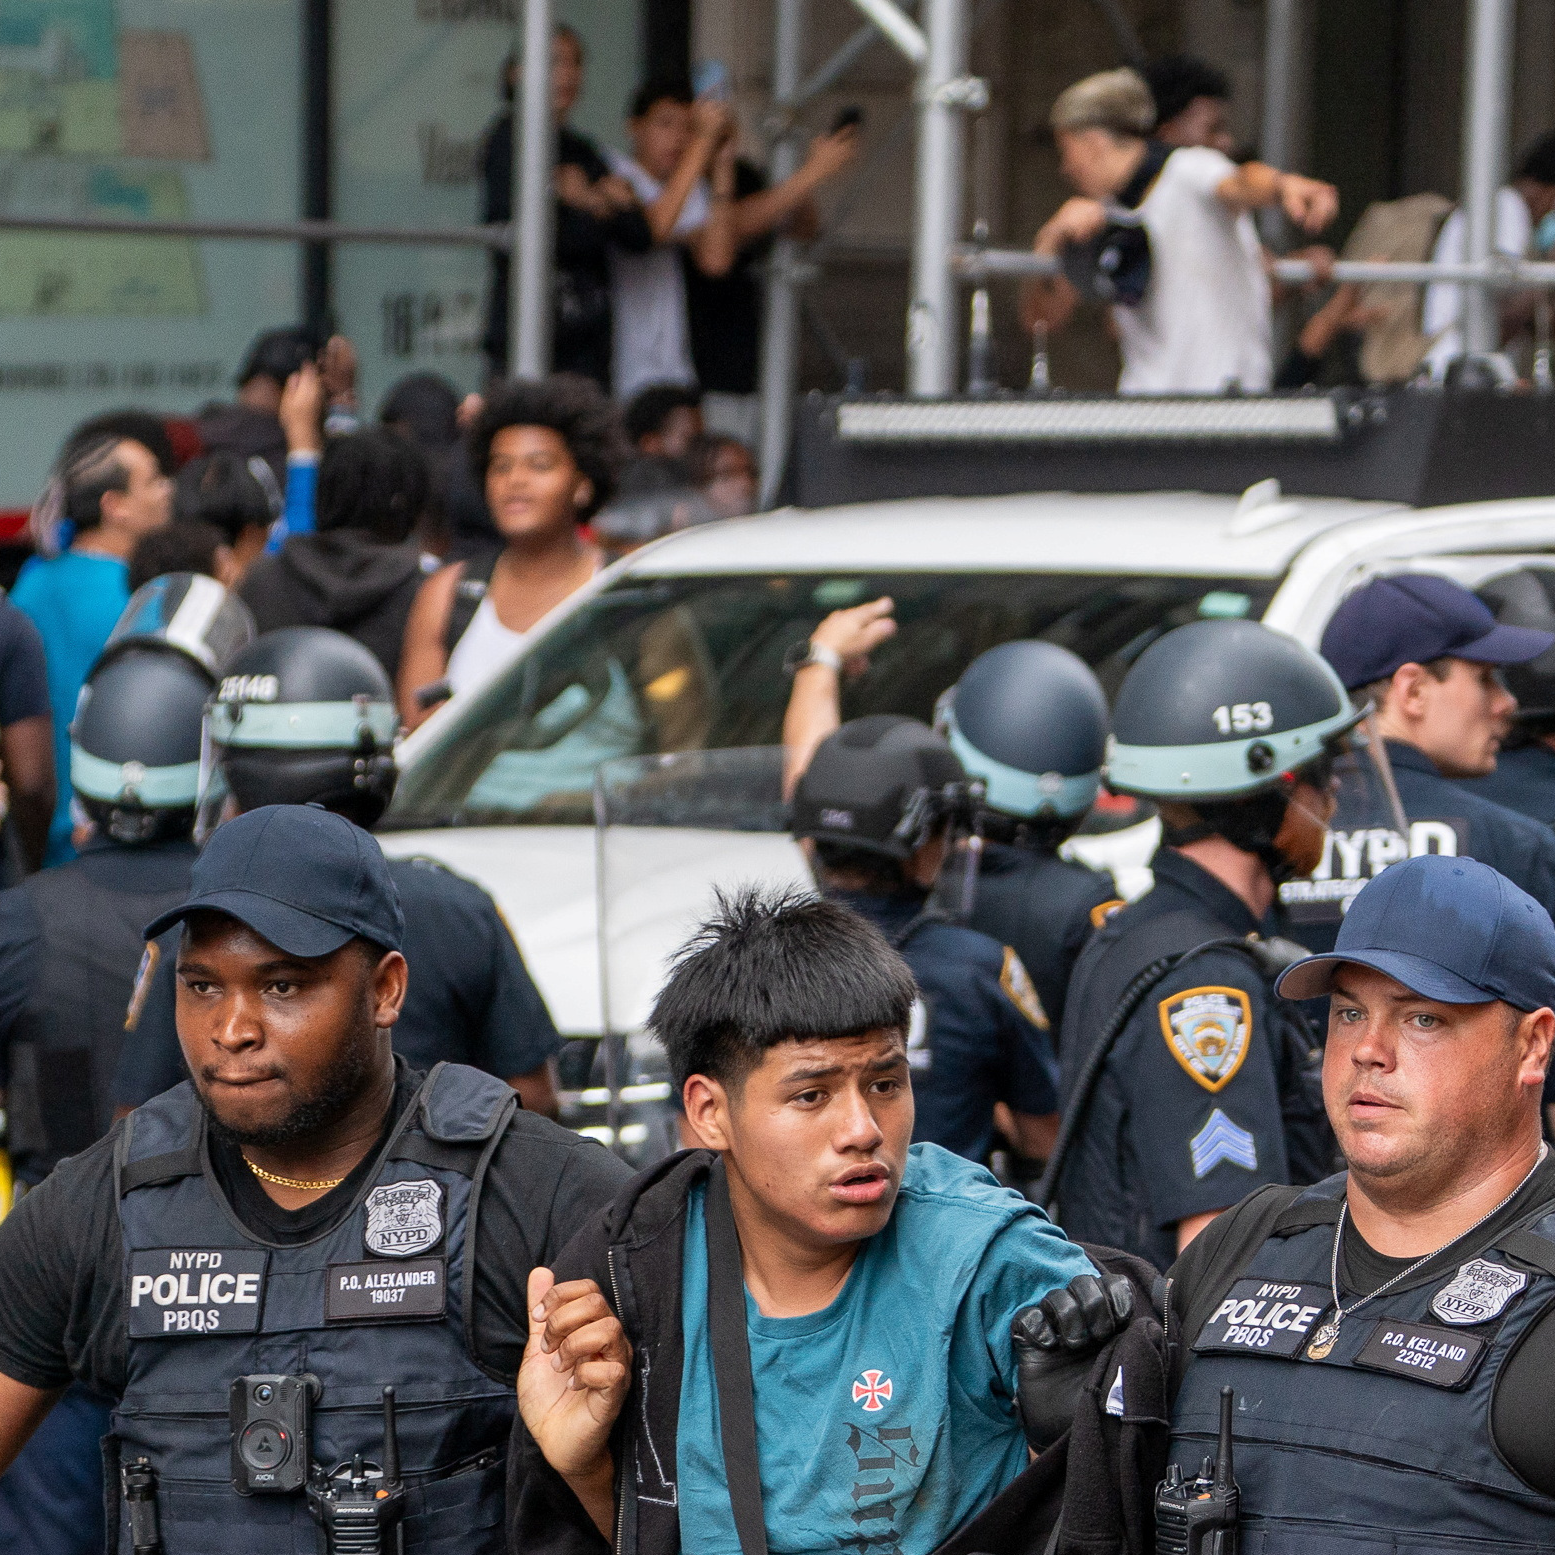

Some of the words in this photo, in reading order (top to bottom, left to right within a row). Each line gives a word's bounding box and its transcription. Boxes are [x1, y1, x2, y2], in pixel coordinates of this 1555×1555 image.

[1212, 701, 1274, 735] 153
[380, 1229, 428, 1244] NYPD
[170, 1252, 222, 1269] NYPD
[131, 1273, 260, 1307] POLICE
[340, 1275, 362, 1290] P.O.
[364, 1270, 436, 1289] ALEXANDER
[370, 1288, 406, 1303] 19037
[1256, 1283, 1301, 1299] NYPD
[1208, 1299, 1321, 1333] POLICE
[1442, 1297, 1485, 1316] NYPD
[163, 1309, 220, 1333] PBQS
[1222, 1325, 1274, 1347] PBQS
[1381, 1332, 1404, 1347] P.O.
[1406, 1336, 1466, 1361] KELLAND
[1395, 1349, 1437, 1370] 22912
[1159, 1501, 1185, 1511] MOTOROLA
